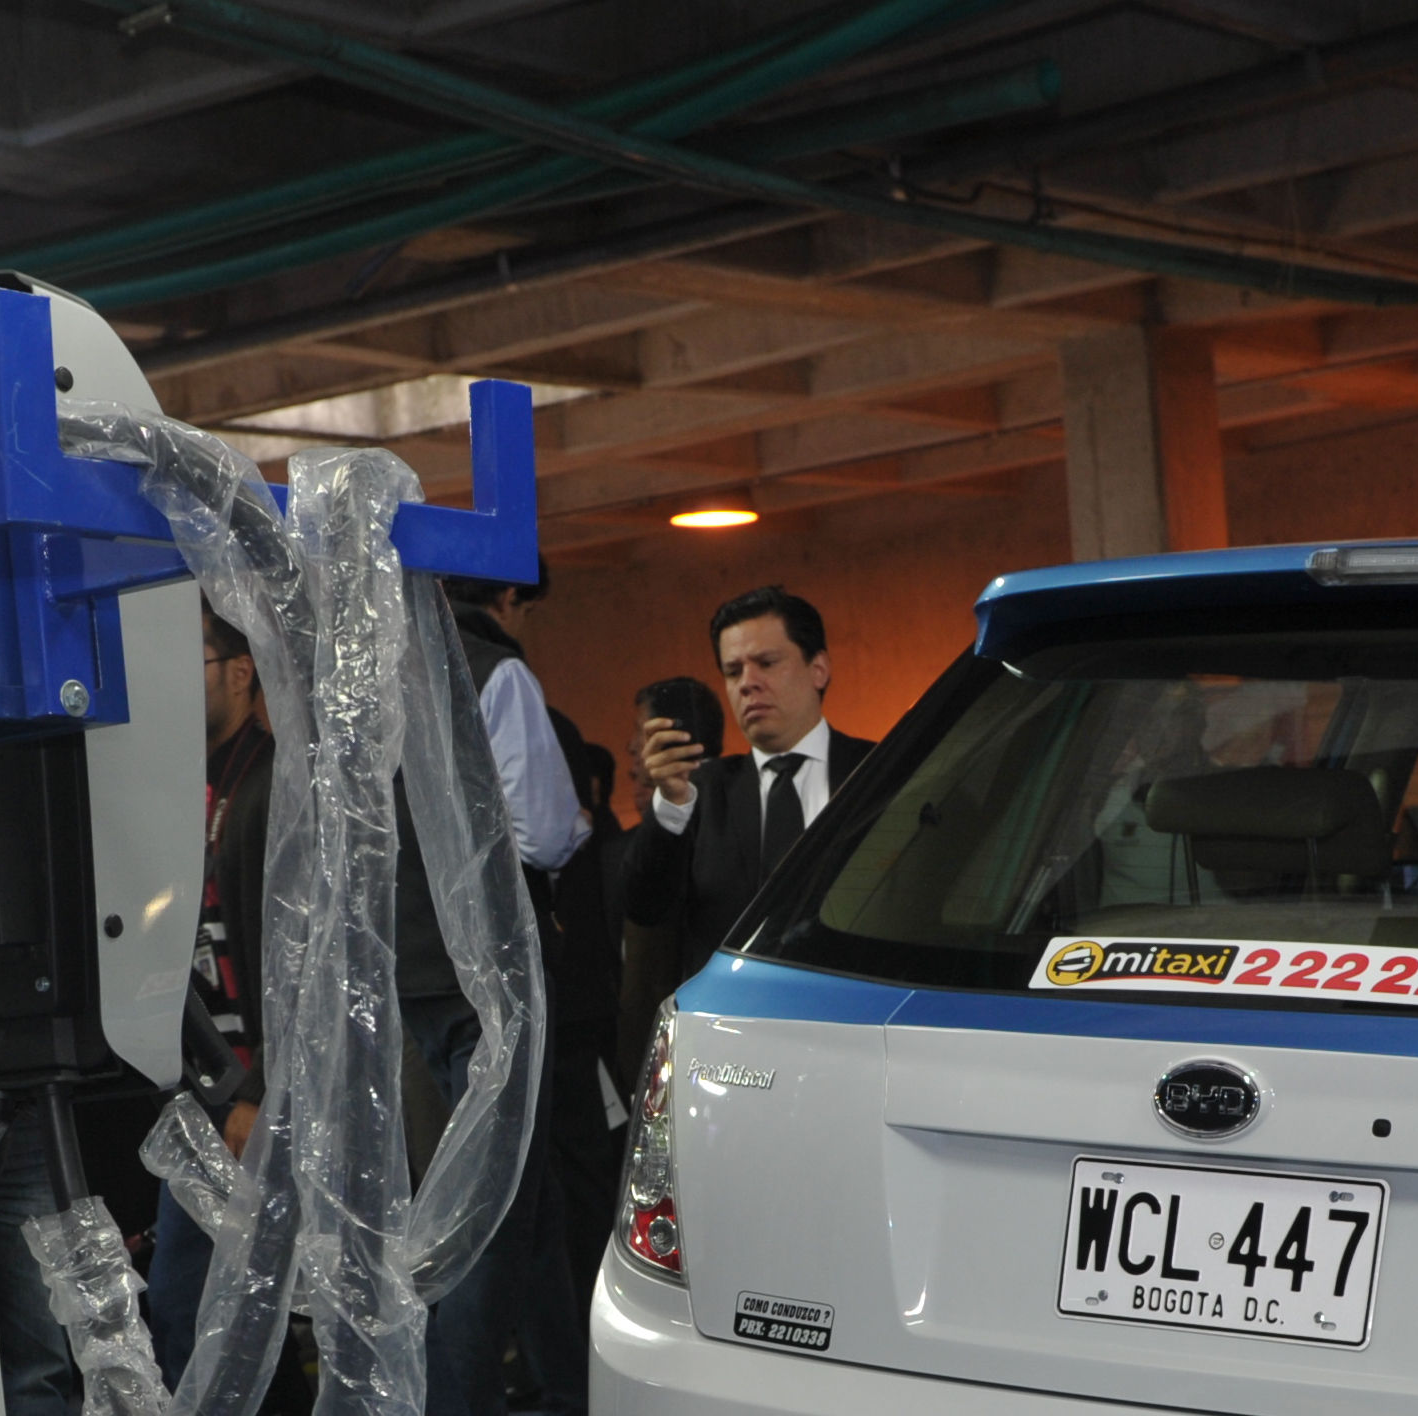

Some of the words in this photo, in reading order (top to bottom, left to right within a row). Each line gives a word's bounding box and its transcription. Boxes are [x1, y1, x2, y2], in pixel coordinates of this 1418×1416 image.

[1102, 947, 1228, 977] mitaxi
[1166, 1082, 1246, 1116] BYD
[1077, 1186, 1199, 1281] WCL
[1227, 1202, 1370, 1297] 447
[743, 1297, 769, 1314] COMO
[771, 1302, 821, 1322] CONDUZCO
[1132, 1285, 1223, 1318] BOGOTA
[1244, 1297, 1284, 1325] D.C.
[739, 1318, 766, 1336] PBX:
[768, 1324, 828, 1346] 2210338
